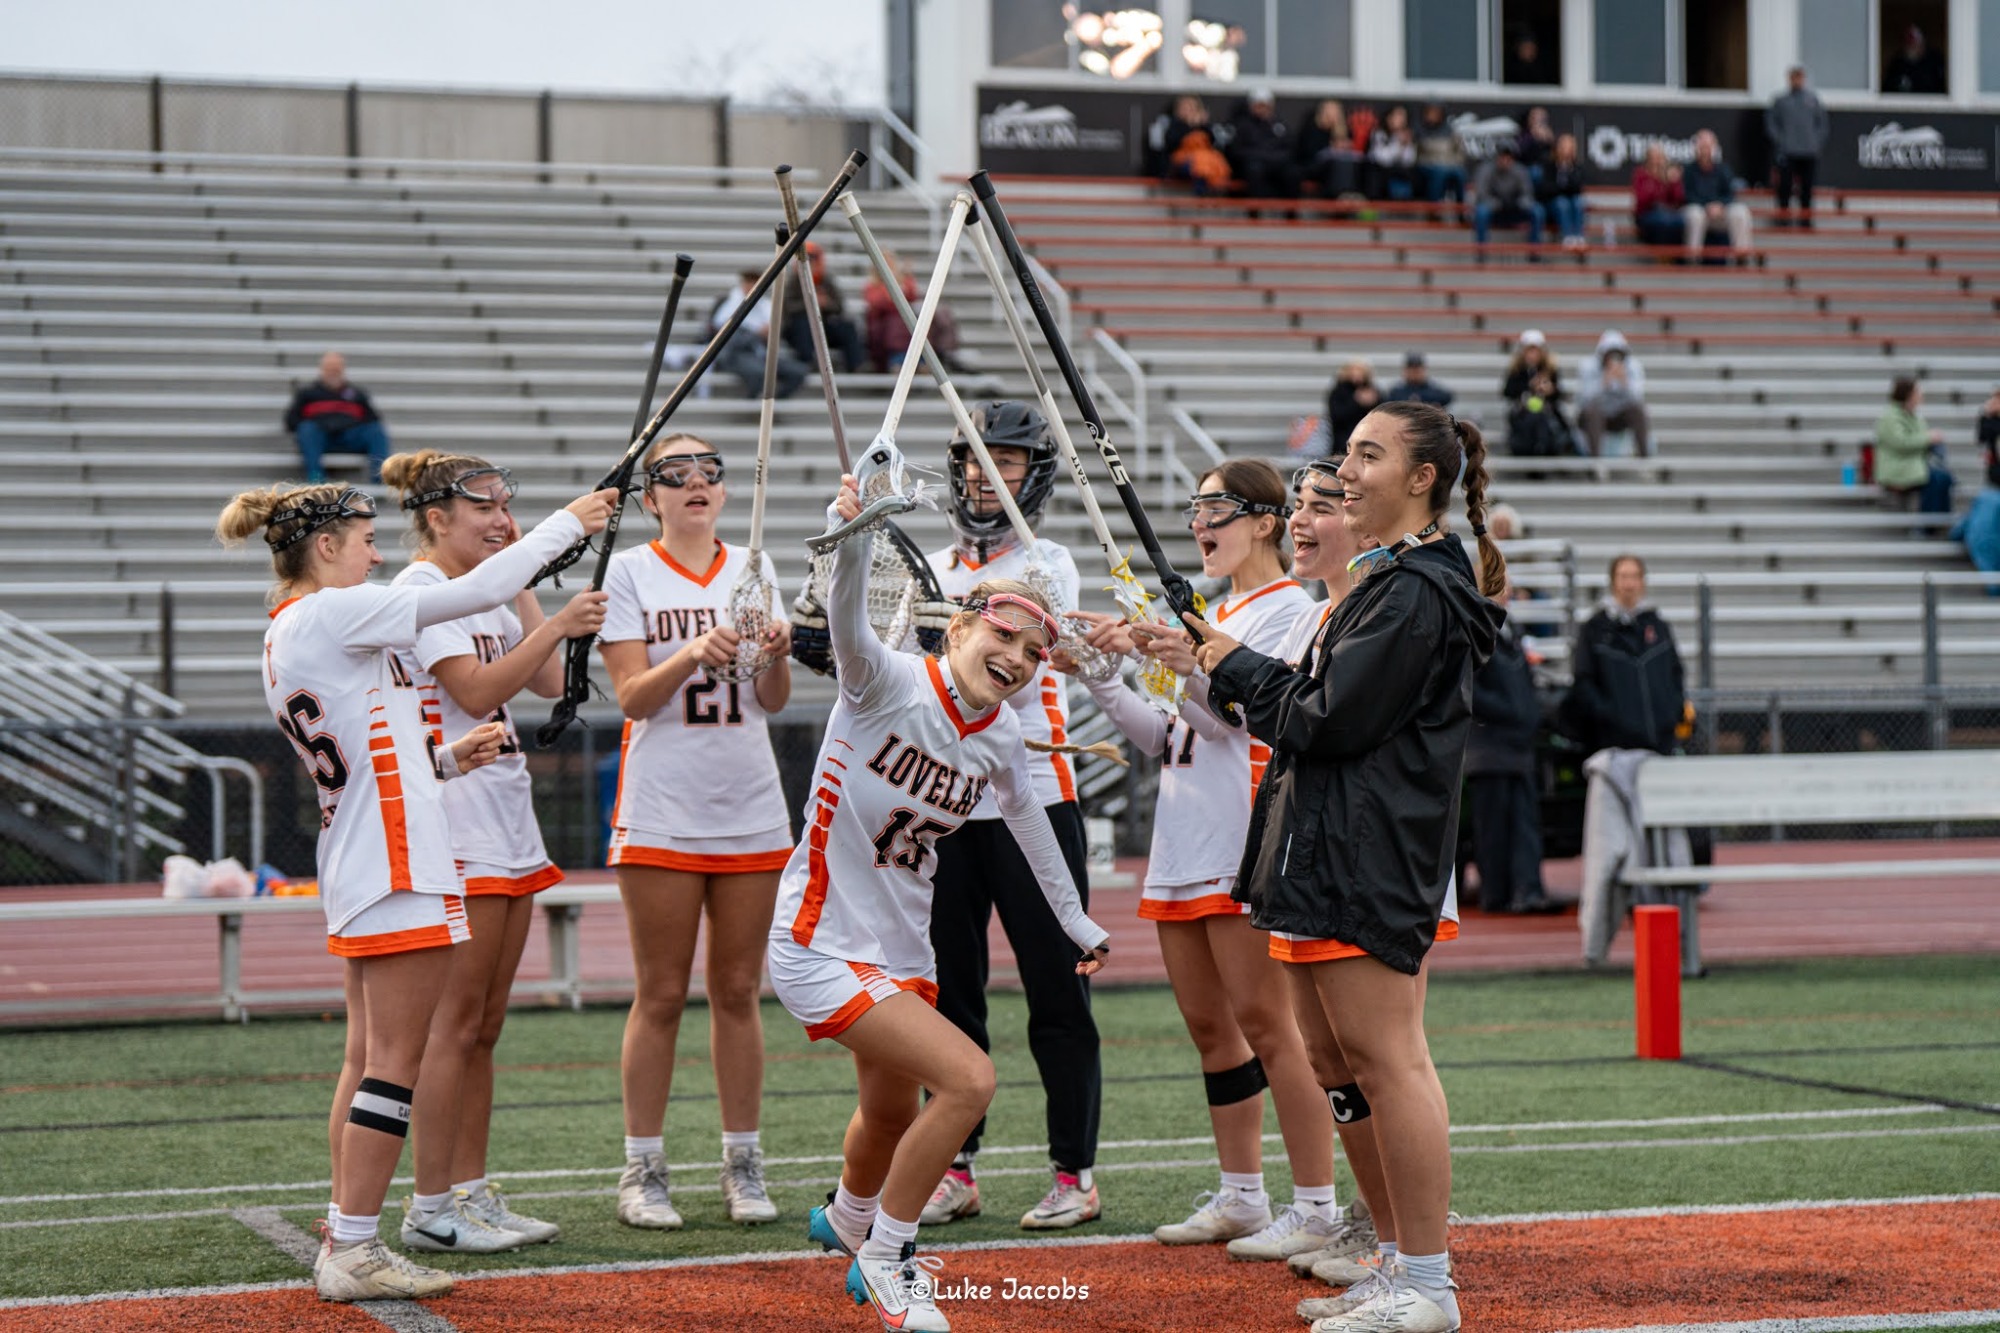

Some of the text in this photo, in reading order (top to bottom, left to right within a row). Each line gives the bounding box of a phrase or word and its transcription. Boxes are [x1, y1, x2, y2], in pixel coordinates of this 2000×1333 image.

[1095, 430, 1130, 486] STX
[274, 510, 295, 523] STX
[423, 490, 445, 501] STX
[1254, 503, 1277, 514] STX
[682, 655, 744, 727] 21
[276, 689, 351, 795] 6
[872, 806, 956, 875] 15
[1328, 1090, 1353, 1122] C
